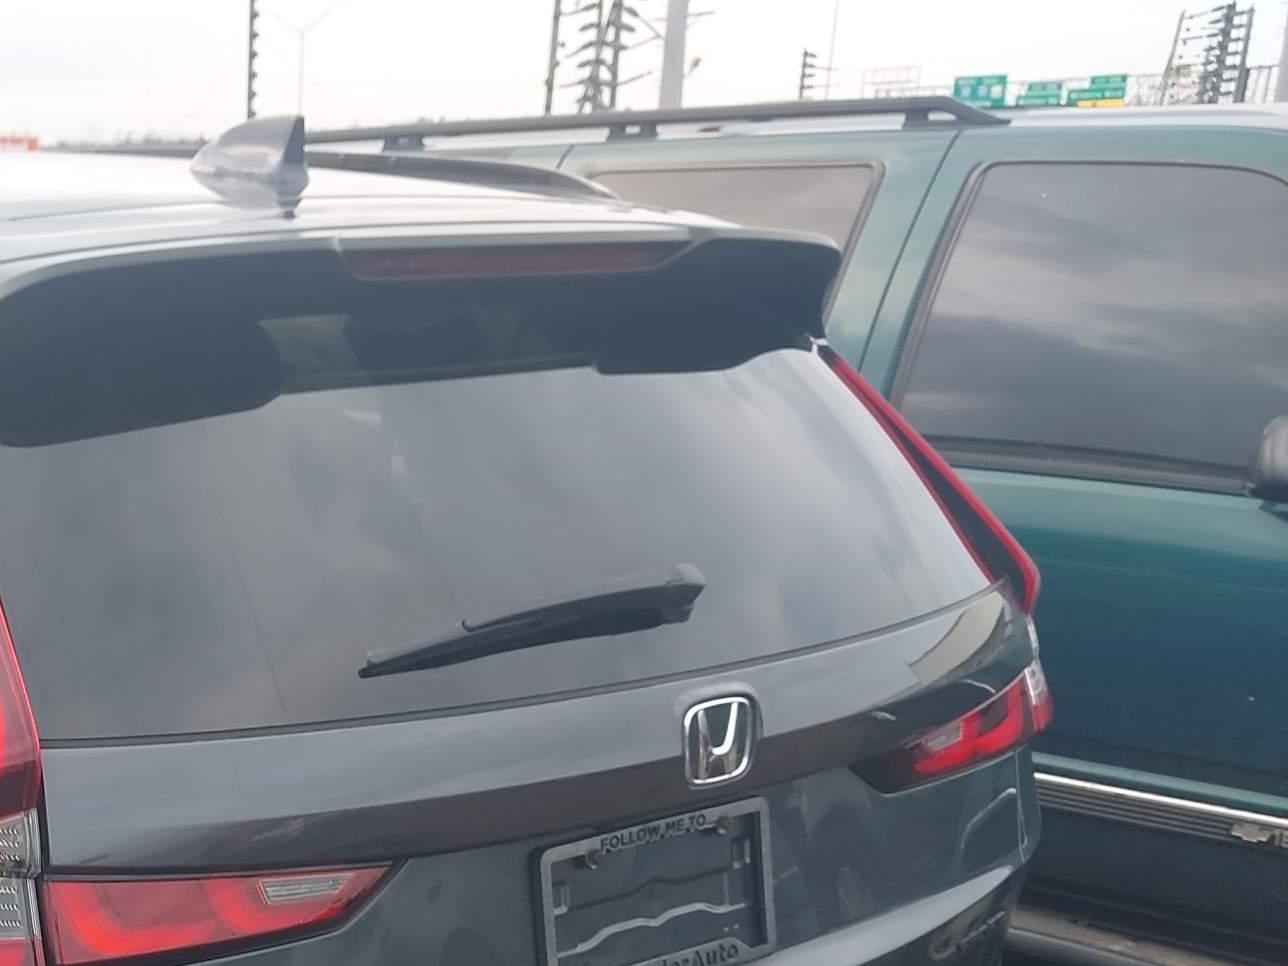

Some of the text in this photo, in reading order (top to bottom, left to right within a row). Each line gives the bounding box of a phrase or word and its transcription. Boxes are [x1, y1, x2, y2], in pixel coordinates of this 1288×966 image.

[600, 814, 706, 852] FOLLOW ME TO
